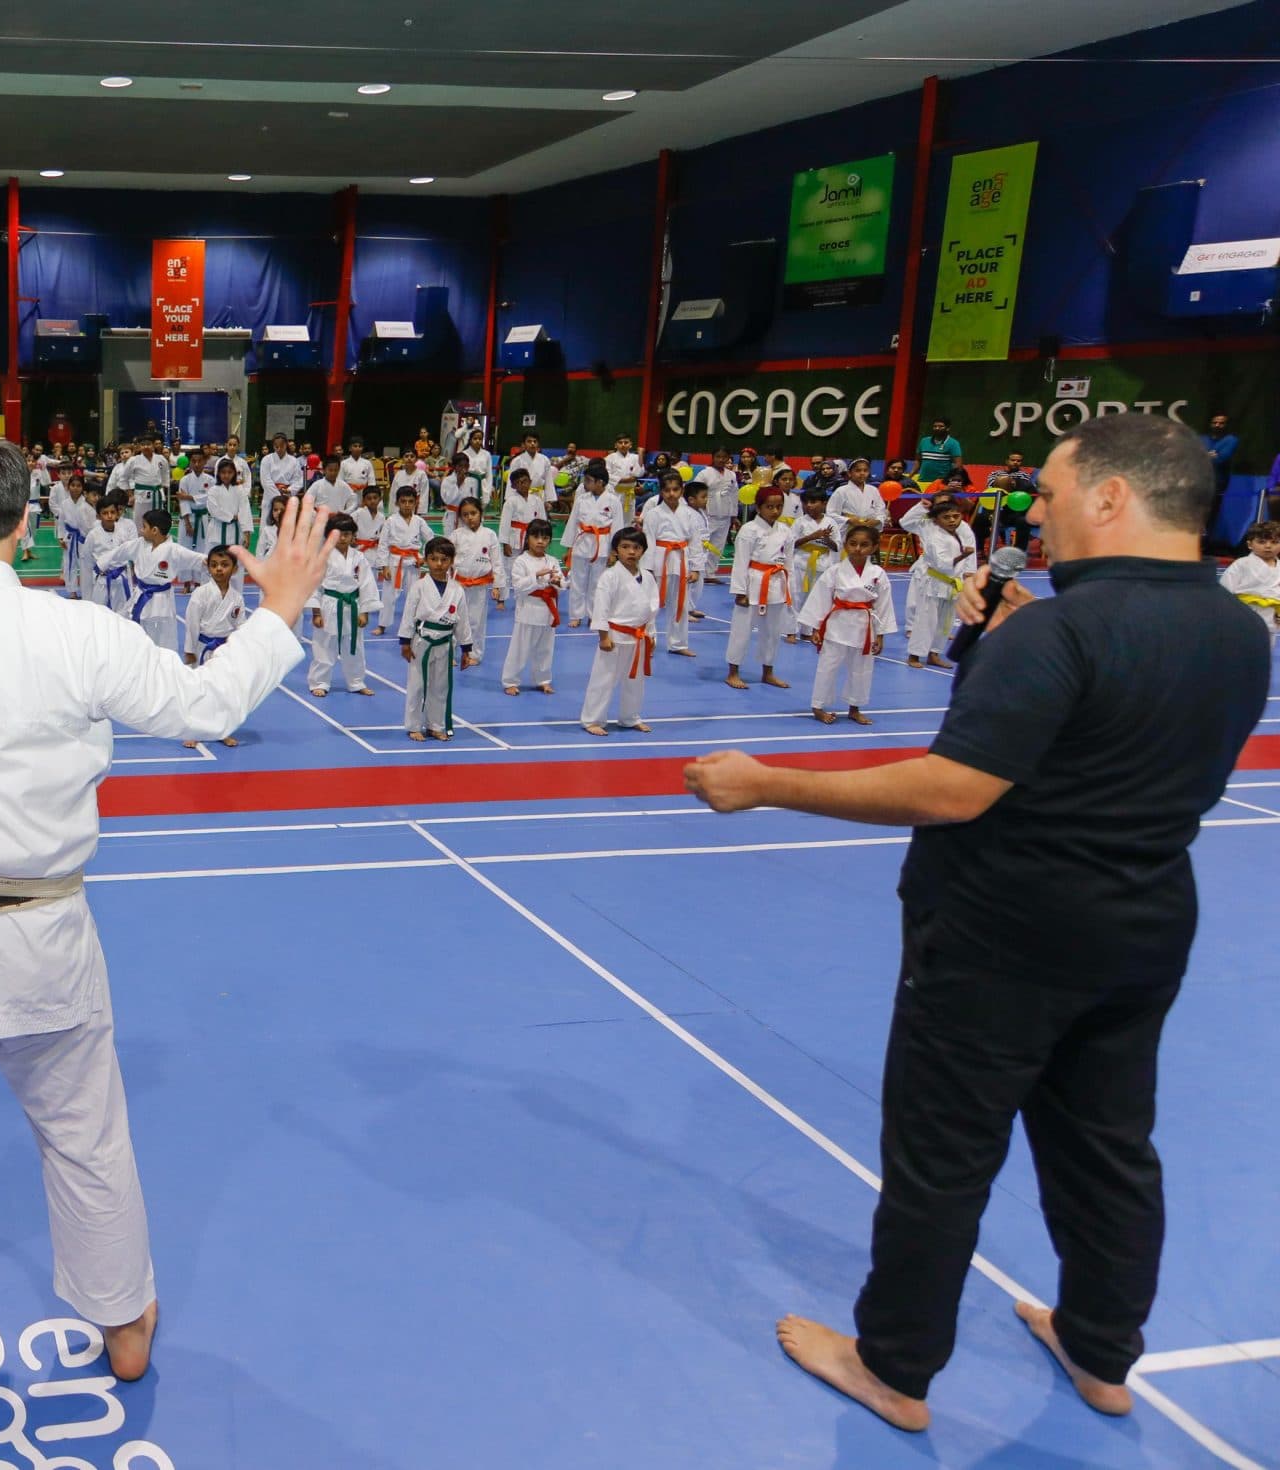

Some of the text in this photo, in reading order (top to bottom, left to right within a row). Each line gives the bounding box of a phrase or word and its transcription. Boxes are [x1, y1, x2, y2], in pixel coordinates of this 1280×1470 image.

[819, 177, 863, 204] Jamil
[818, 240, 850, 251] crocs
[956, 246, 1005, 262] PLACE
[958, 261, 999, 275] YOUR
[966, 277, 988, 289] AD
[955, 290, 995, 305] HERE
[162, 304, 193, 313] PLACE
[164, 314, 191, 323] YOUR
[164, 333, 190, 342] HERE
[666, 385, 881, 438] ENGAGE
